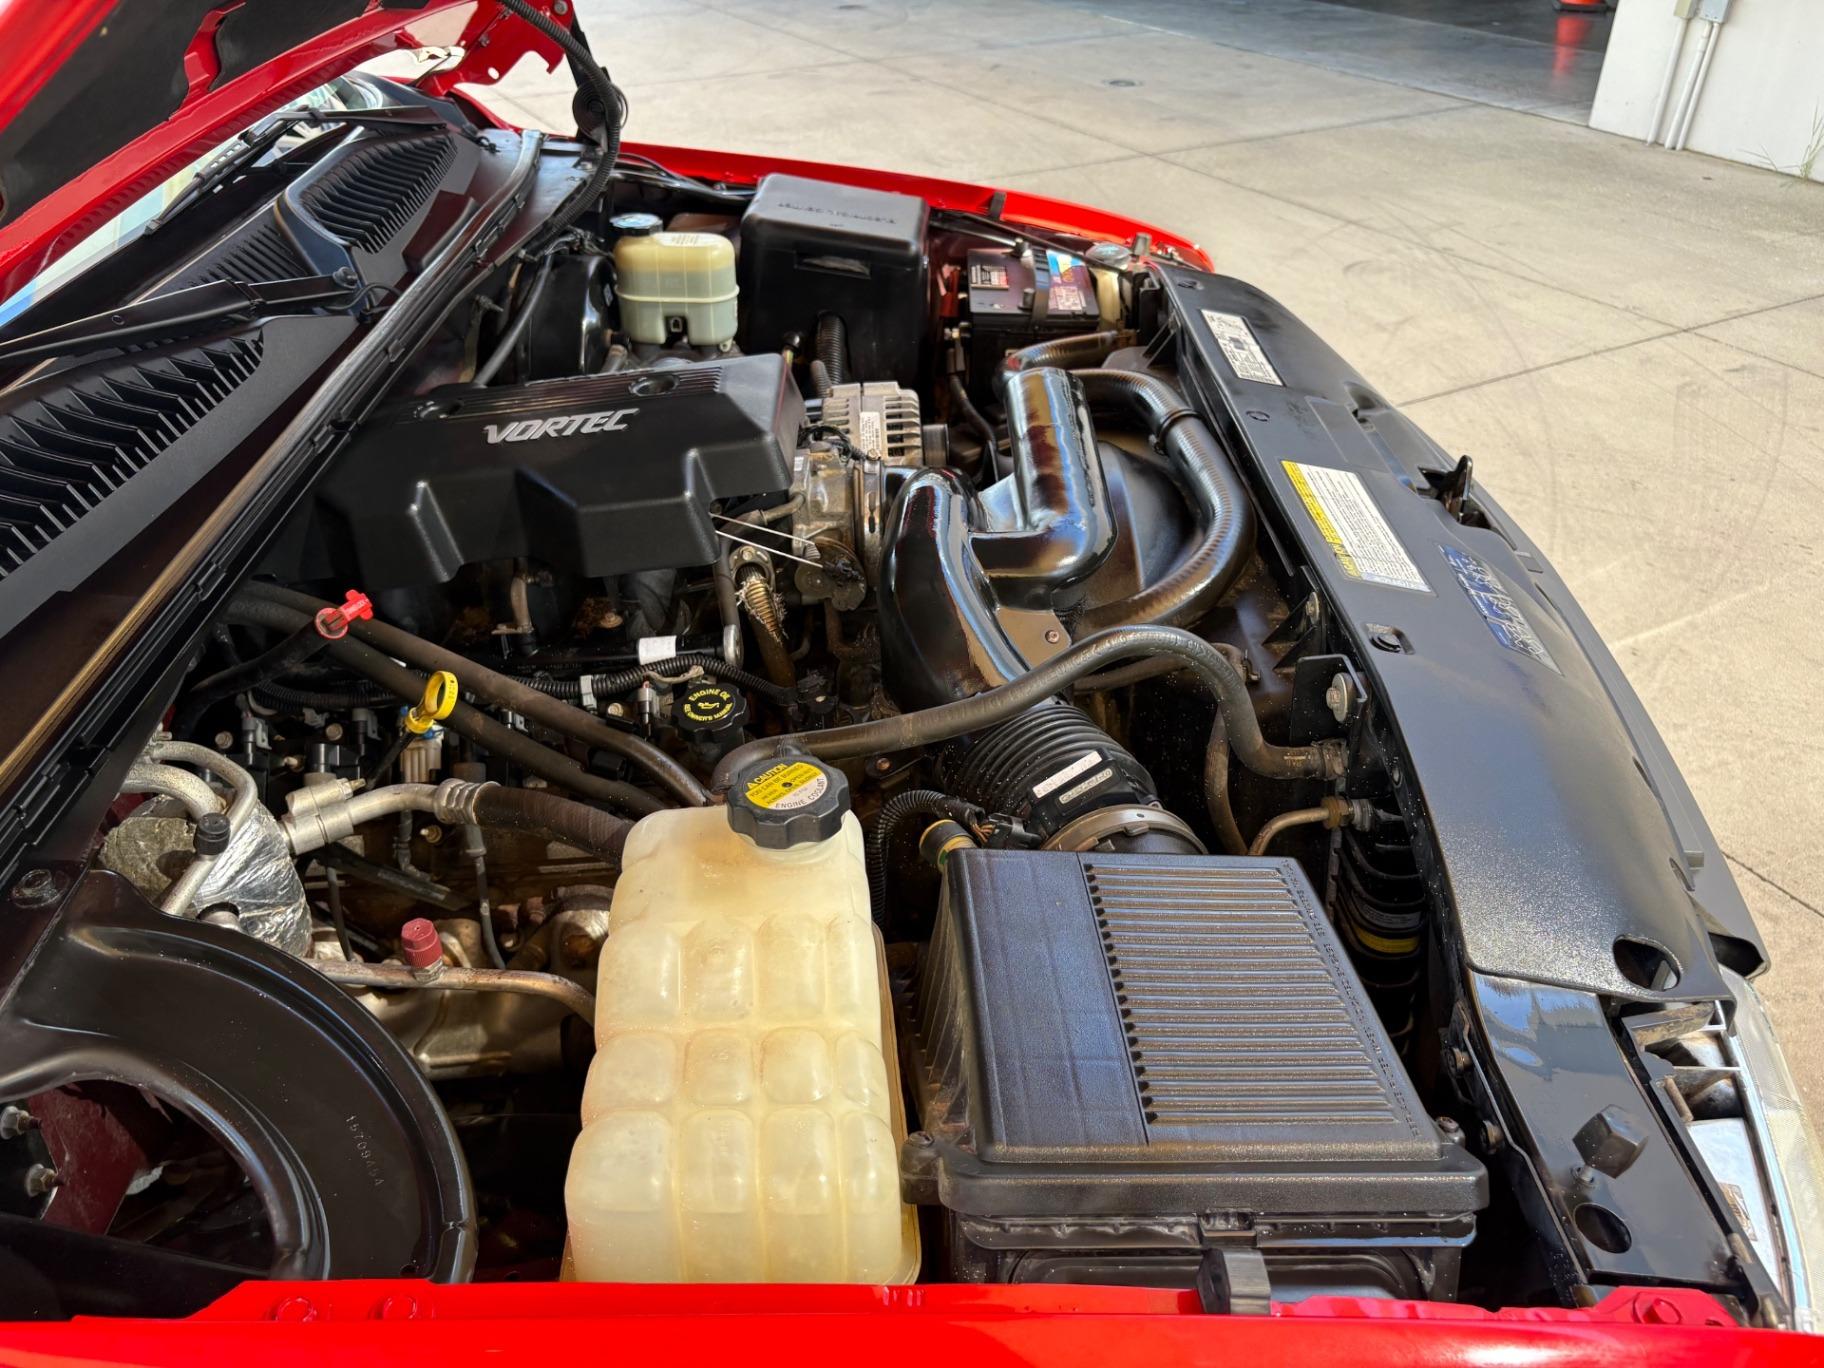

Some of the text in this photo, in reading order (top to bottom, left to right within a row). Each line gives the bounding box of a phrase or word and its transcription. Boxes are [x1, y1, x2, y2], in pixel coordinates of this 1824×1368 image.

[483, 408, 640, 444] VORTEC
[688, 688, 720, 701] ENGINE
[753, 763, 788, 783] CAUTION
[775, 799, 807, 809] ENGINE
[808, 778, 825, 801] COOLANT
